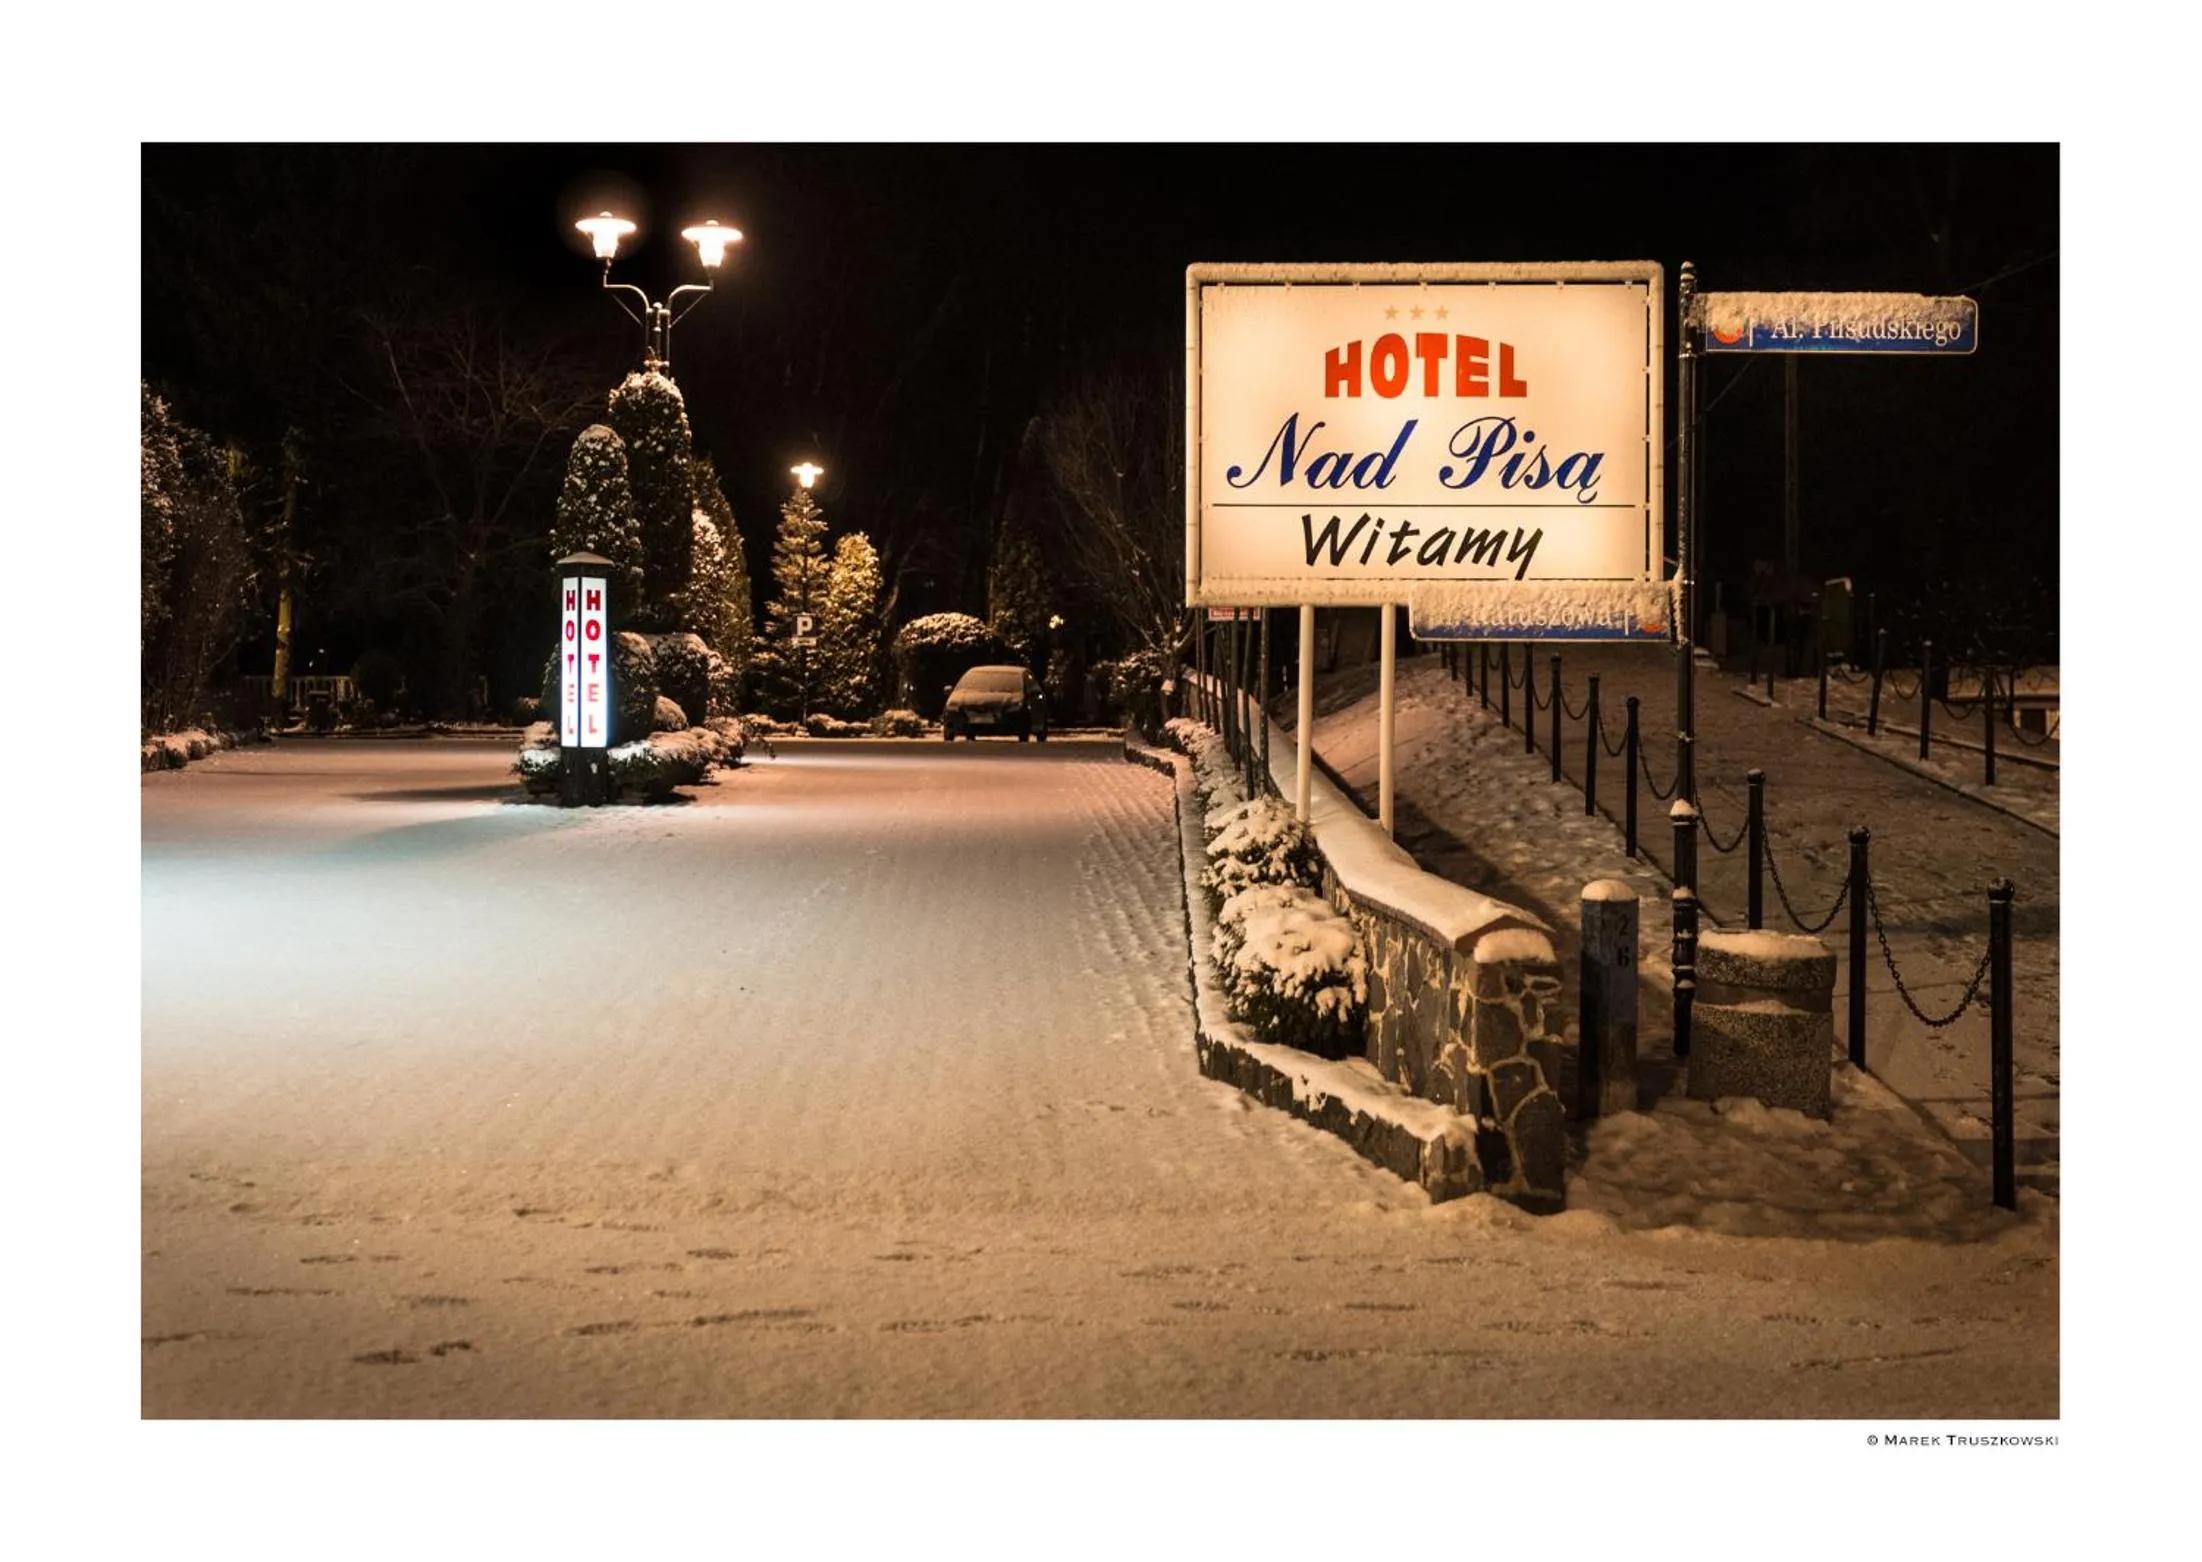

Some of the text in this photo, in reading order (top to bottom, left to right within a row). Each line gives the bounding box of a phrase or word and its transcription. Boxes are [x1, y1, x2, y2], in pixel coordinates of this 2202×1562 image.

[1324, 332, 1528, 399] HOTEL
[1226, 412, 1605, 504] Nad Pisą
[1301, 512, 1544, 581] Witamy
[565, 589, 577, 735] HOTEL
[585, 589, 602, 735] HOTEL
[797, 616, 812, 637] P
